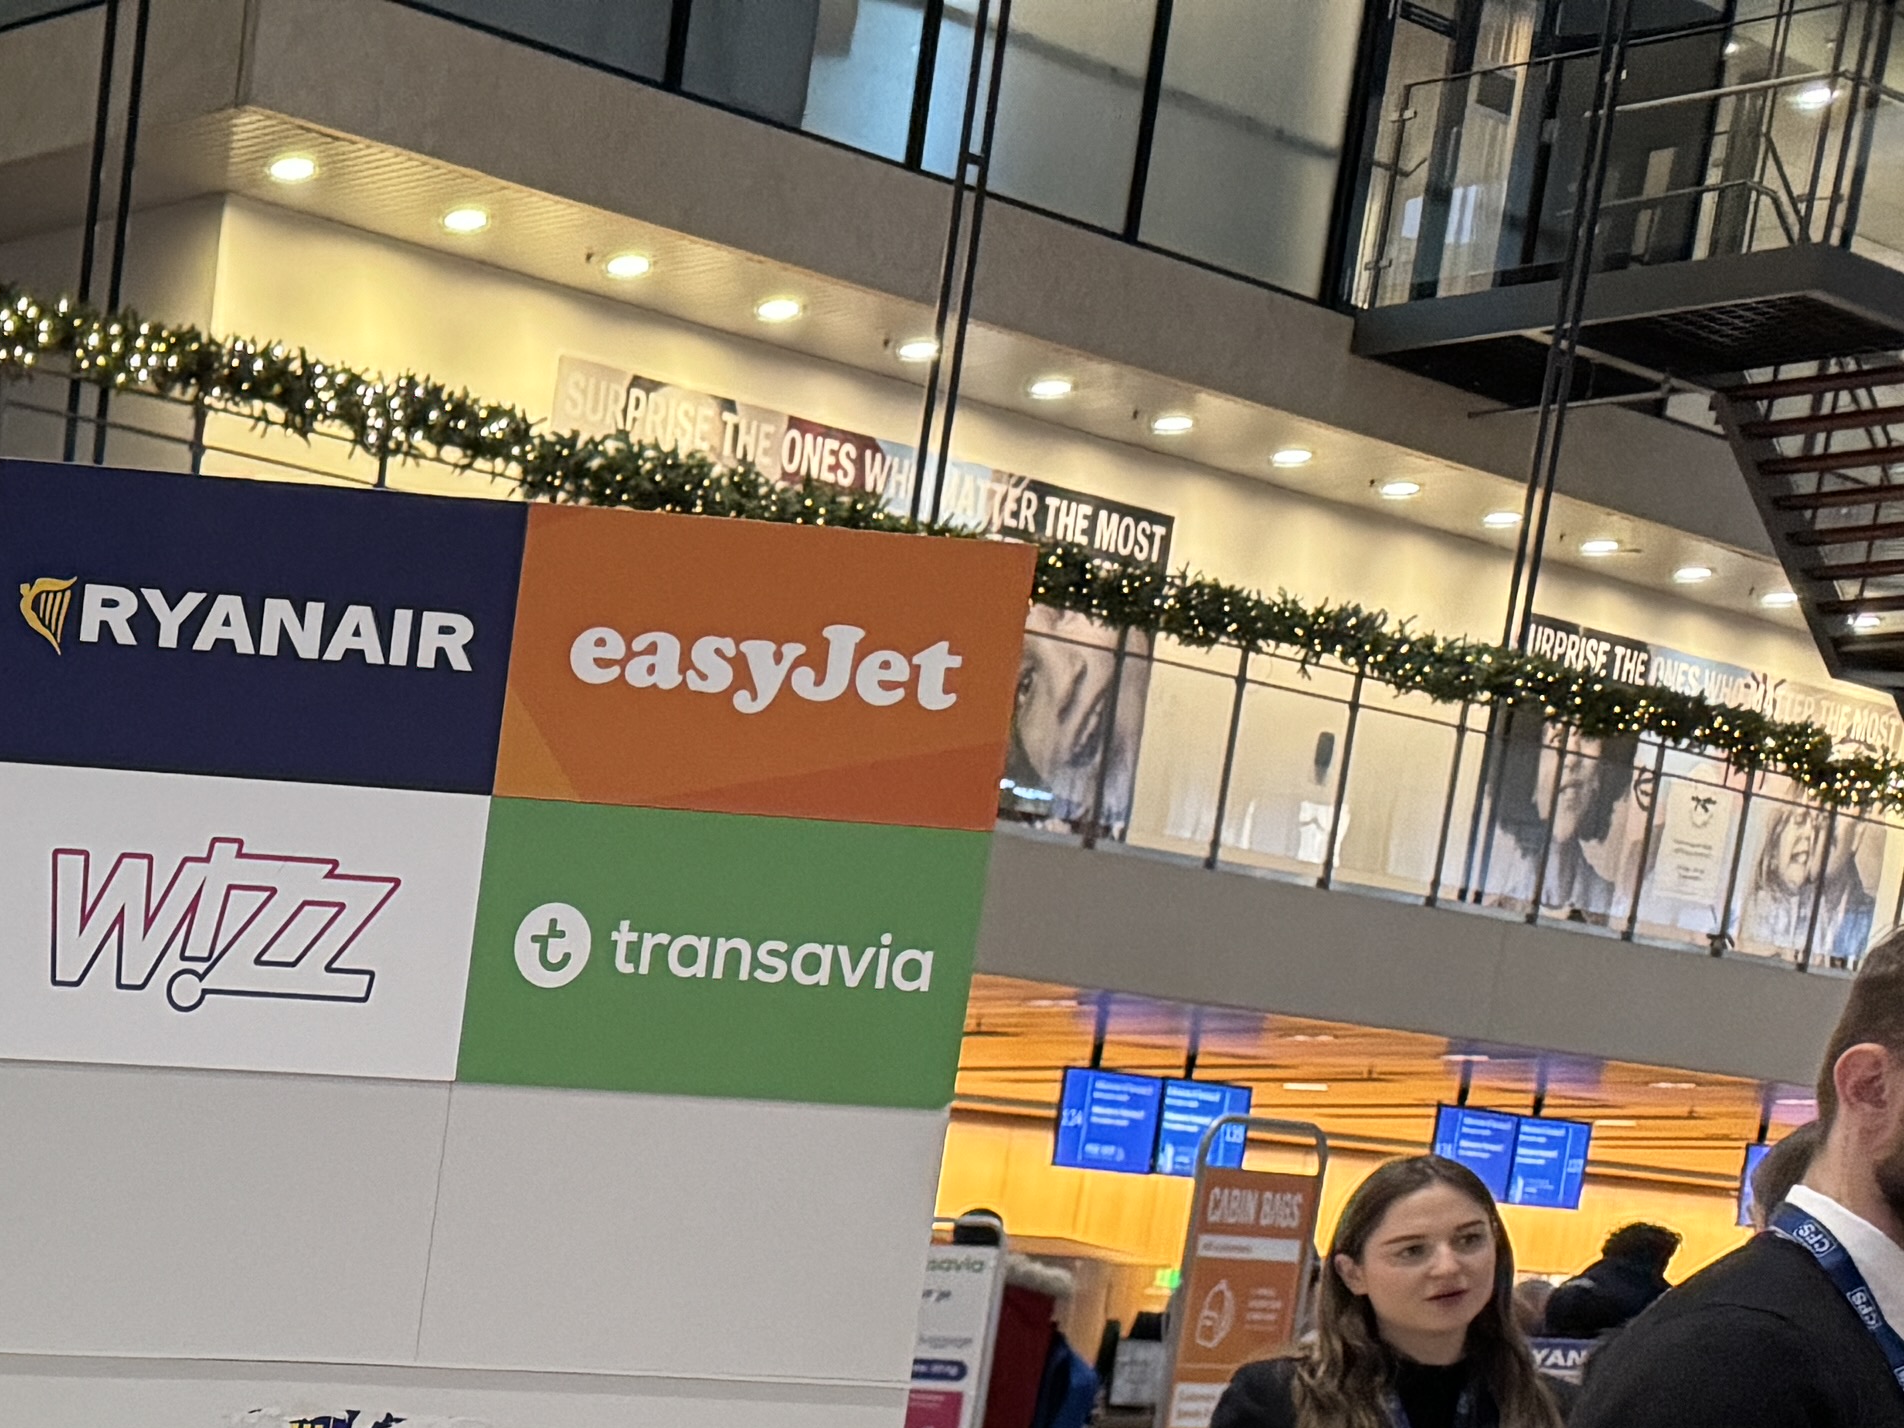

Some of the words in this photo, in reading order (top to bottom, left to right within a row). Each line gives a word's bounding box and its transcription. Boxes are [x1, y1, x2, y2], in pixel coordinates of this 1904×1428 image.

[722, 411, 775, 462] THE
[781, 428, 858, 488] ONES
[1044, 496, 1093, 546] THE
[1093, 508, 1167, 564] MOST
[79, 582, 474, 673] RYANAIR
[569, 623, 963, 714] easyJet
[611, 920, 935, 995] transavia
